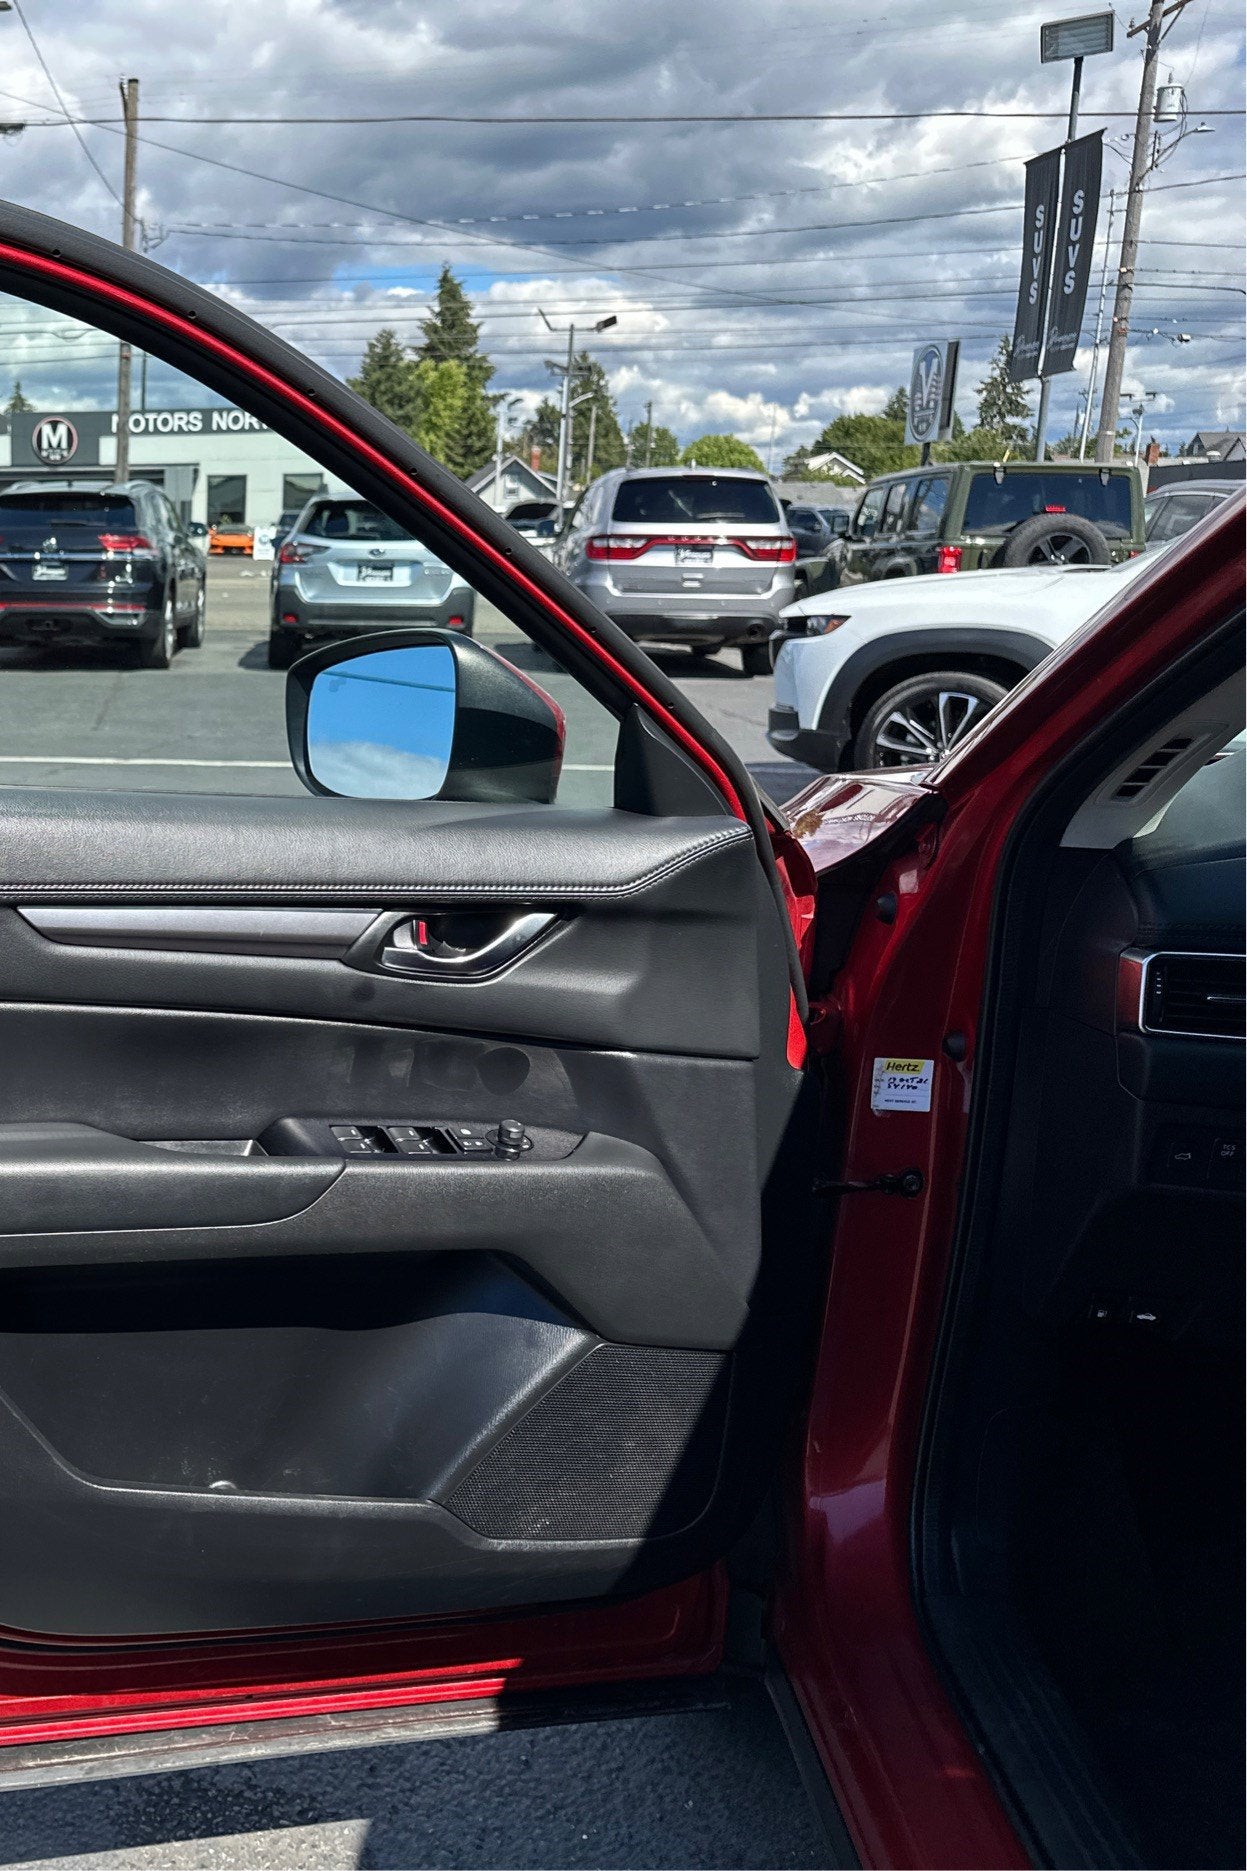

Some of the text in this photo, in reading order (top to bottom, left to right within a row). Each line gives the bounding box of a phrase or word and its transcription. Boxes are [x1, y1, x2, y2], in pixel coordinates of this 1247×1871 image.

[1028, 204, 1045, 305] SUVS
[1063, 190, 1085, 295] SUVS
[41, 423, 68, 449] M
[212, 410, 268, 431] NOR
